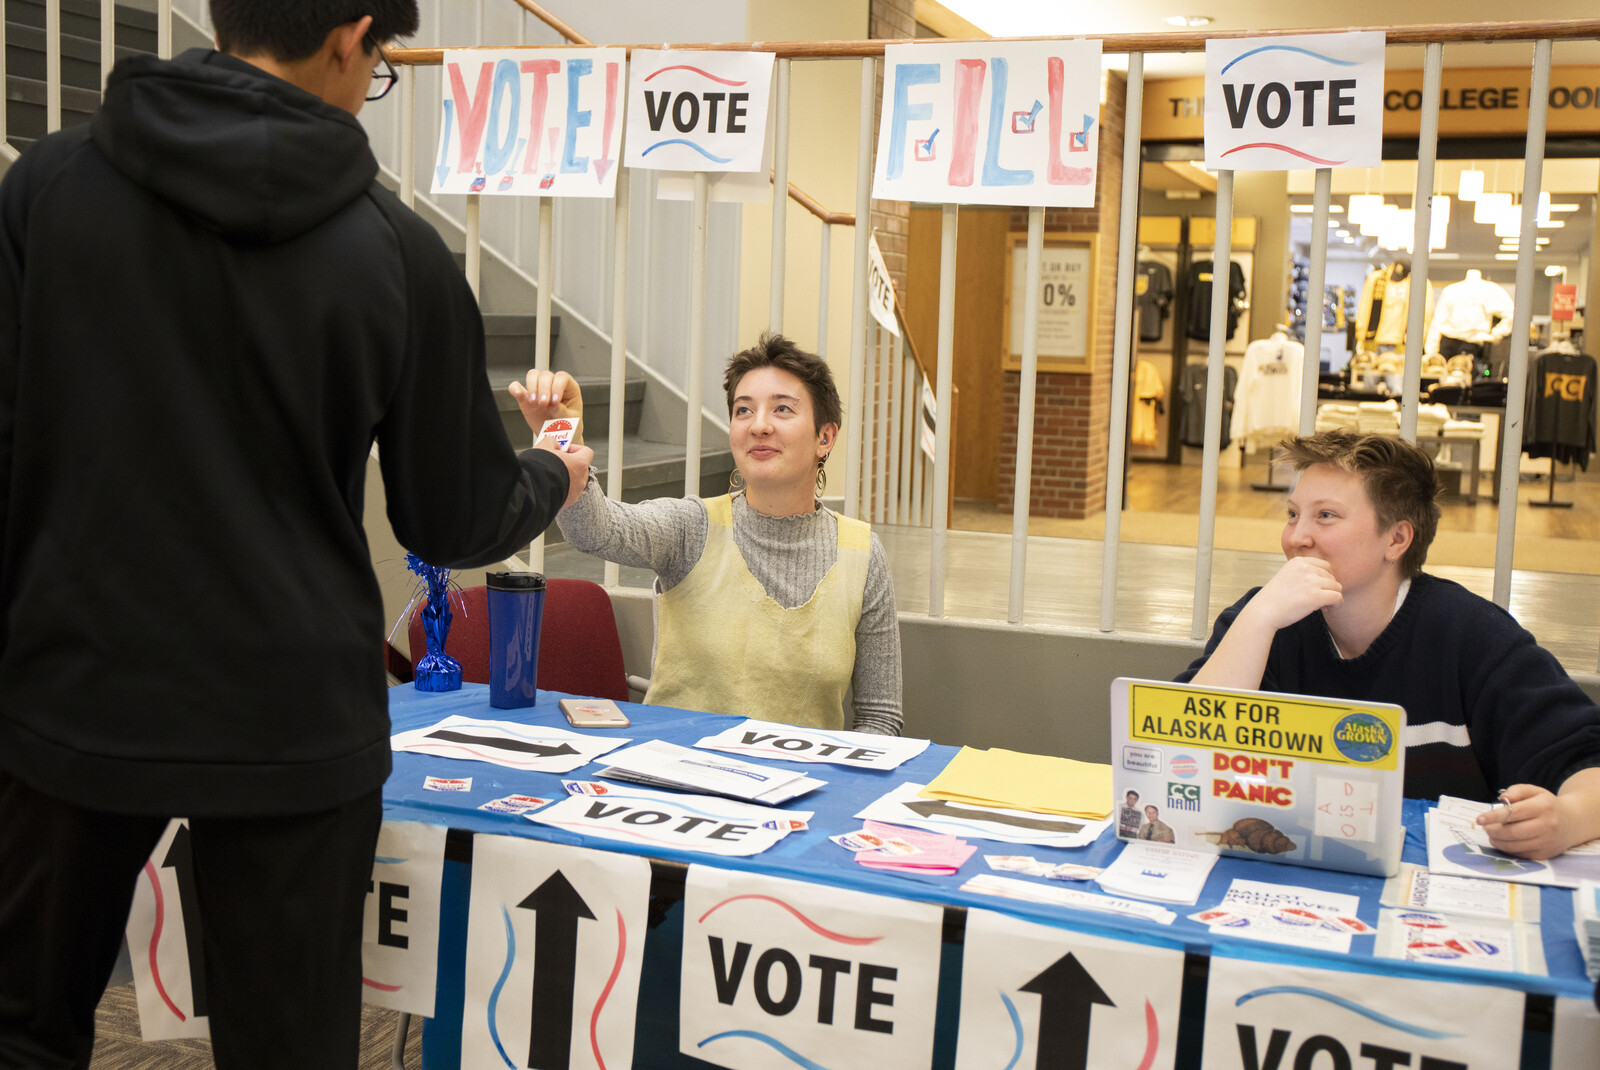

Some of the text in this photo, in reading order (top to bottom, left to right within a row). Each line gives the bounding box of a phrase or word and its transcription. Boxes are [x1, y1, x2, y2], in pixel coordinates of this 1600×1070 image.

[644, 90, 749, 133] VOTE
[1169, 97, 1204, 117] TH
[1384, 87, 1519, 111] COLEGE
[1222, 79, 1357, 129] VOTE
[887, 57, 1093, 187] FILL
[1183, 696, 1280, 725] ASK FOR
[1142, 715, 1323, 753] ALASKA GROWN
[1337, 730, 1386, 744] GROWN
[1344, 722, 1385, 736] Alaska
[740, 731, 887, 762] VOTE
[1212, 752, 1294, 780] DON'T
[1170, 784, 1198, 800] CC
[1212, 779, 1293, 807] PANIC
[584, 801, 759, 841] VOTE
[708, 935, 898, 1035] VOTE
[1236, 1023, 1468, 1070] VOT
